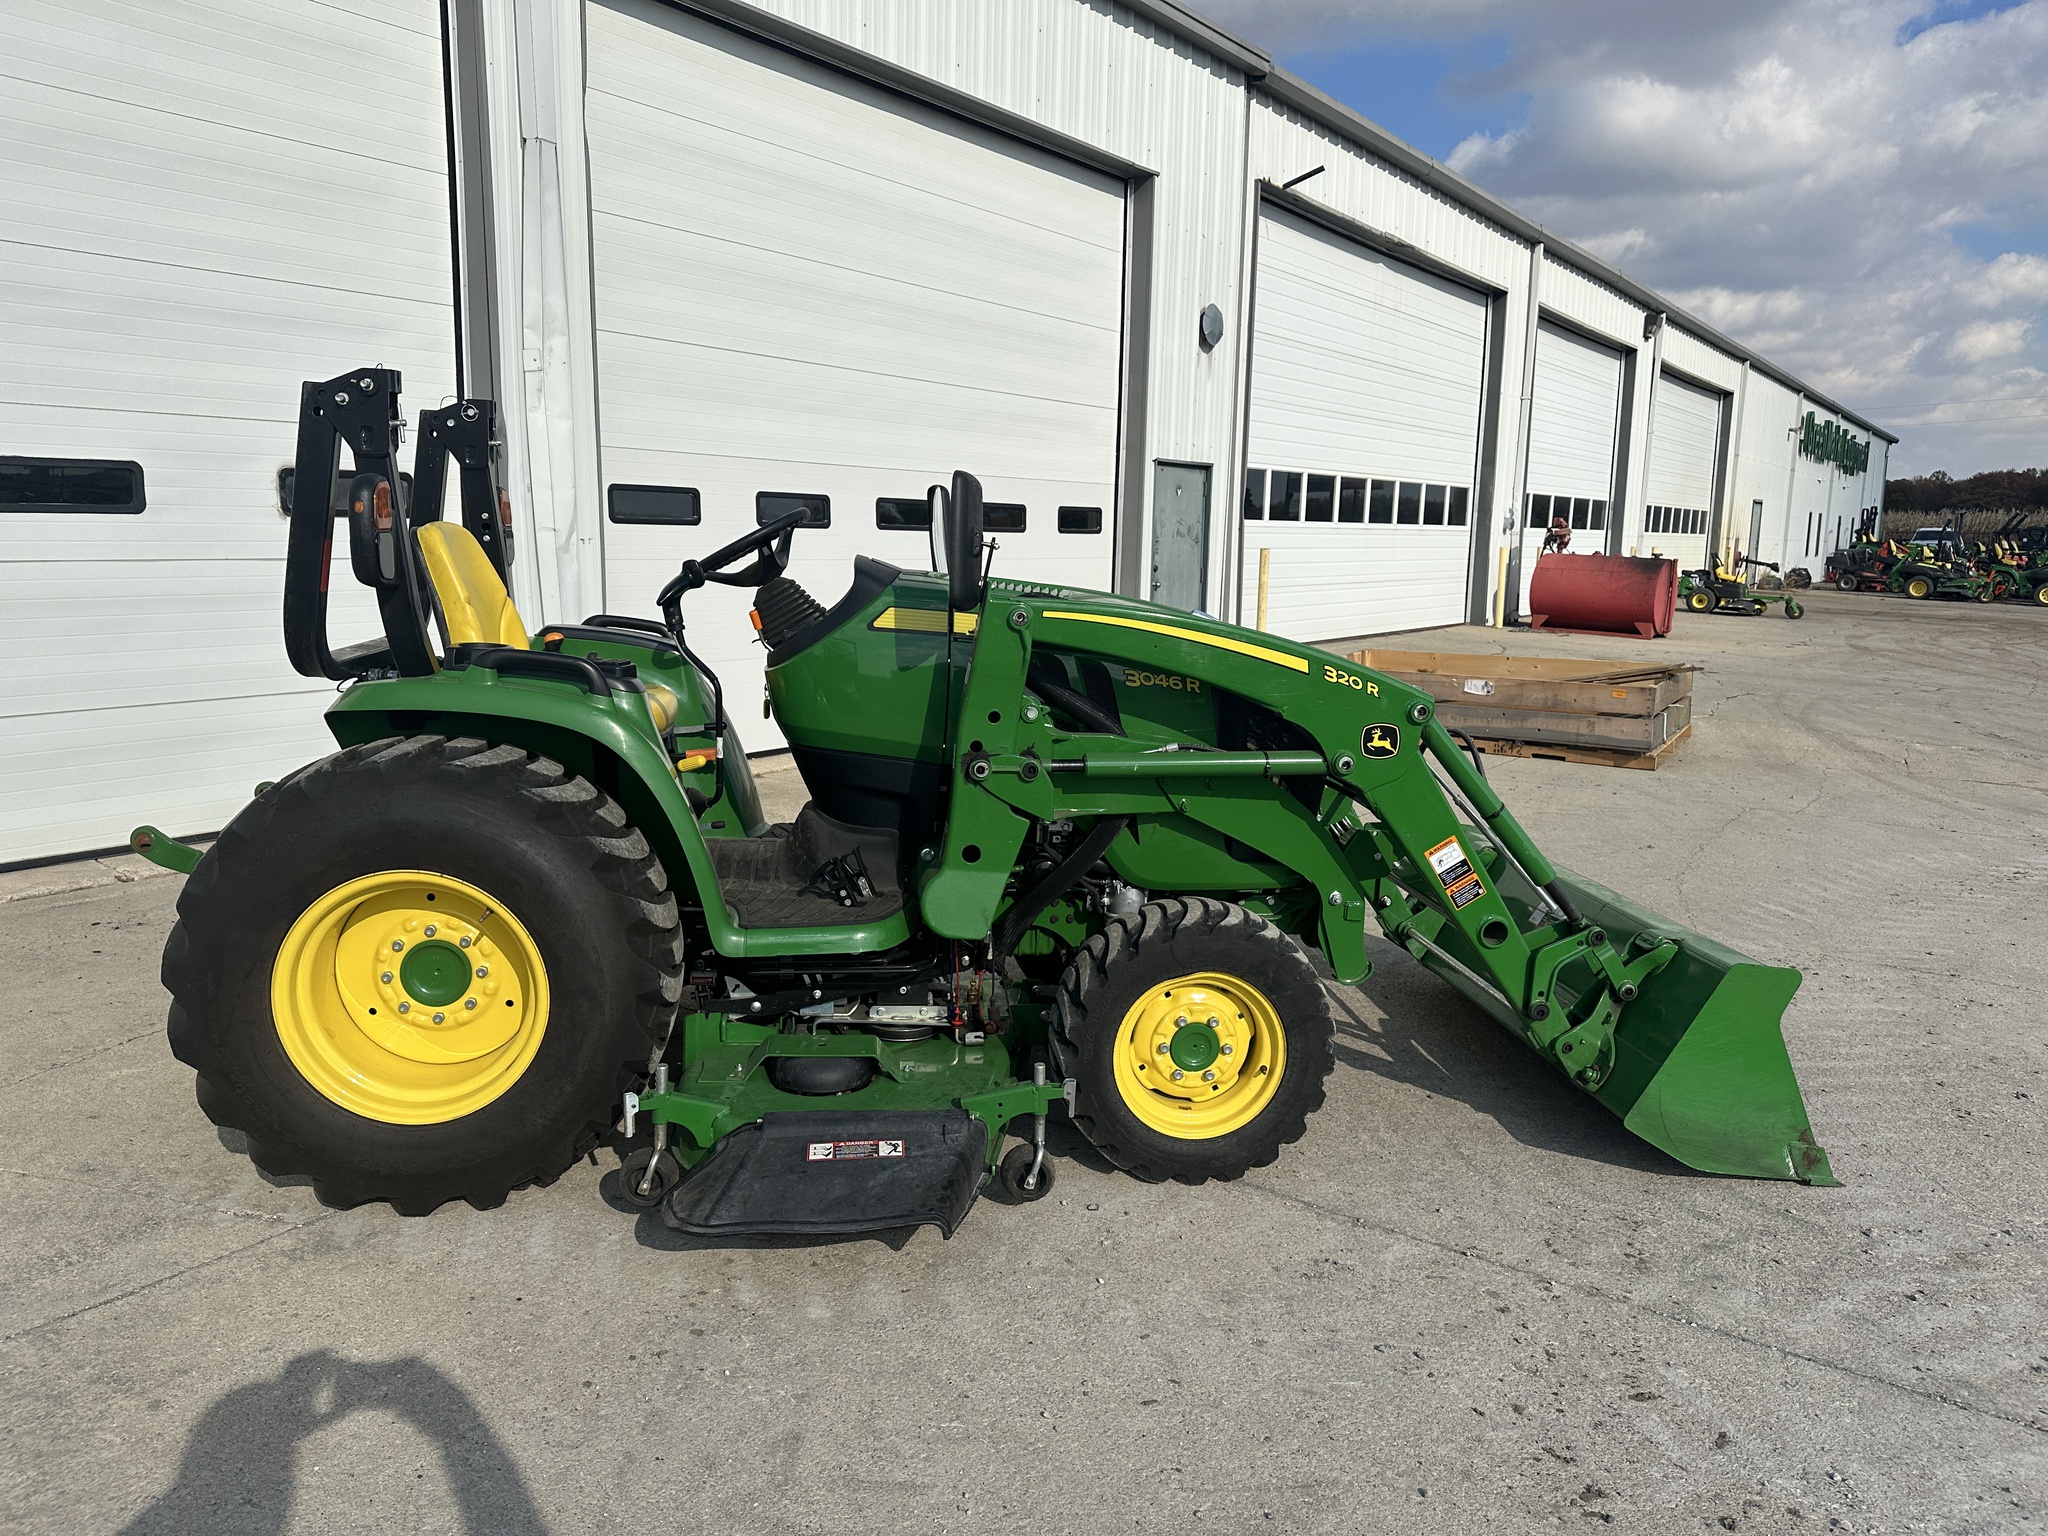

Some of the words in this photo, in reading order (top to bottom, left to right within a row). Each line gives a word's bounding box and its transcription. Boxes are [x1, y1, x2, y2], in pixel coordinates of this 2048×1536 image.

[1123, 668, 1183, 691] 3046
[1185, 677, 1201, 694] R
[1323, 664, 1363, 691] 320
[1366, 680, 1380, 699] R
